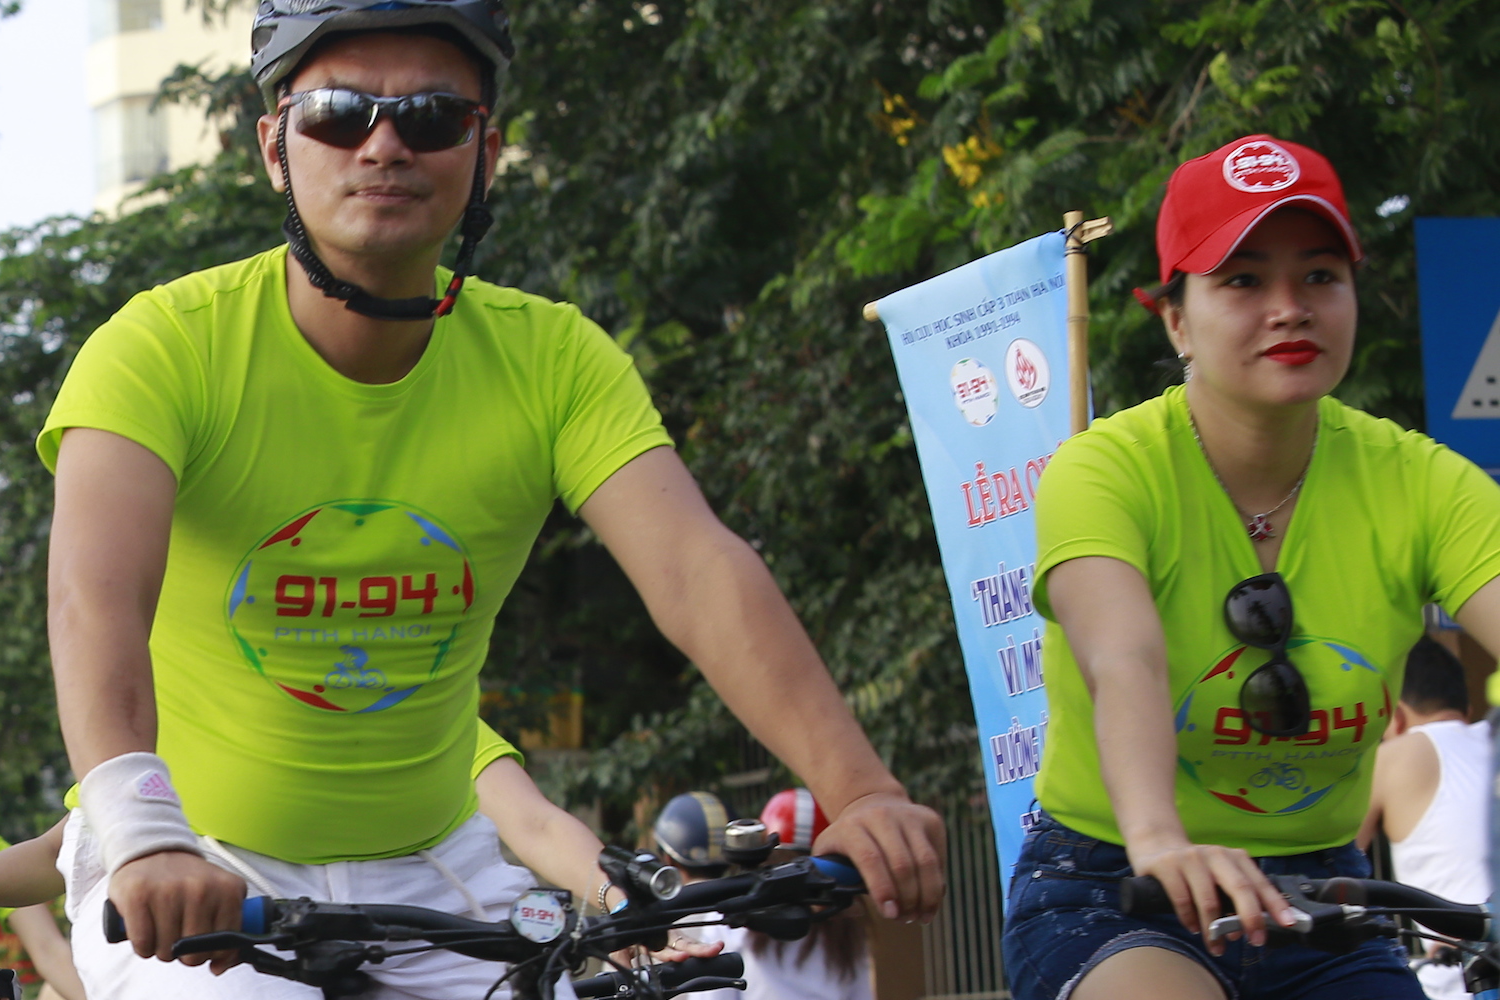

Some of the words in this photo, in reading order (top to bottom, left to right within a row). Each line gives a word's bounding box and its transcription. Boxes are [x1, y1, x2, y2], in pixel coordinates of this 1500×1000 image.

[990, 466, 1029, 519] RA
[274, 573, 439, 618] 91-94
[274, 626, 339, 643] PTTH
[352, 624, 432, 641] HANOI
